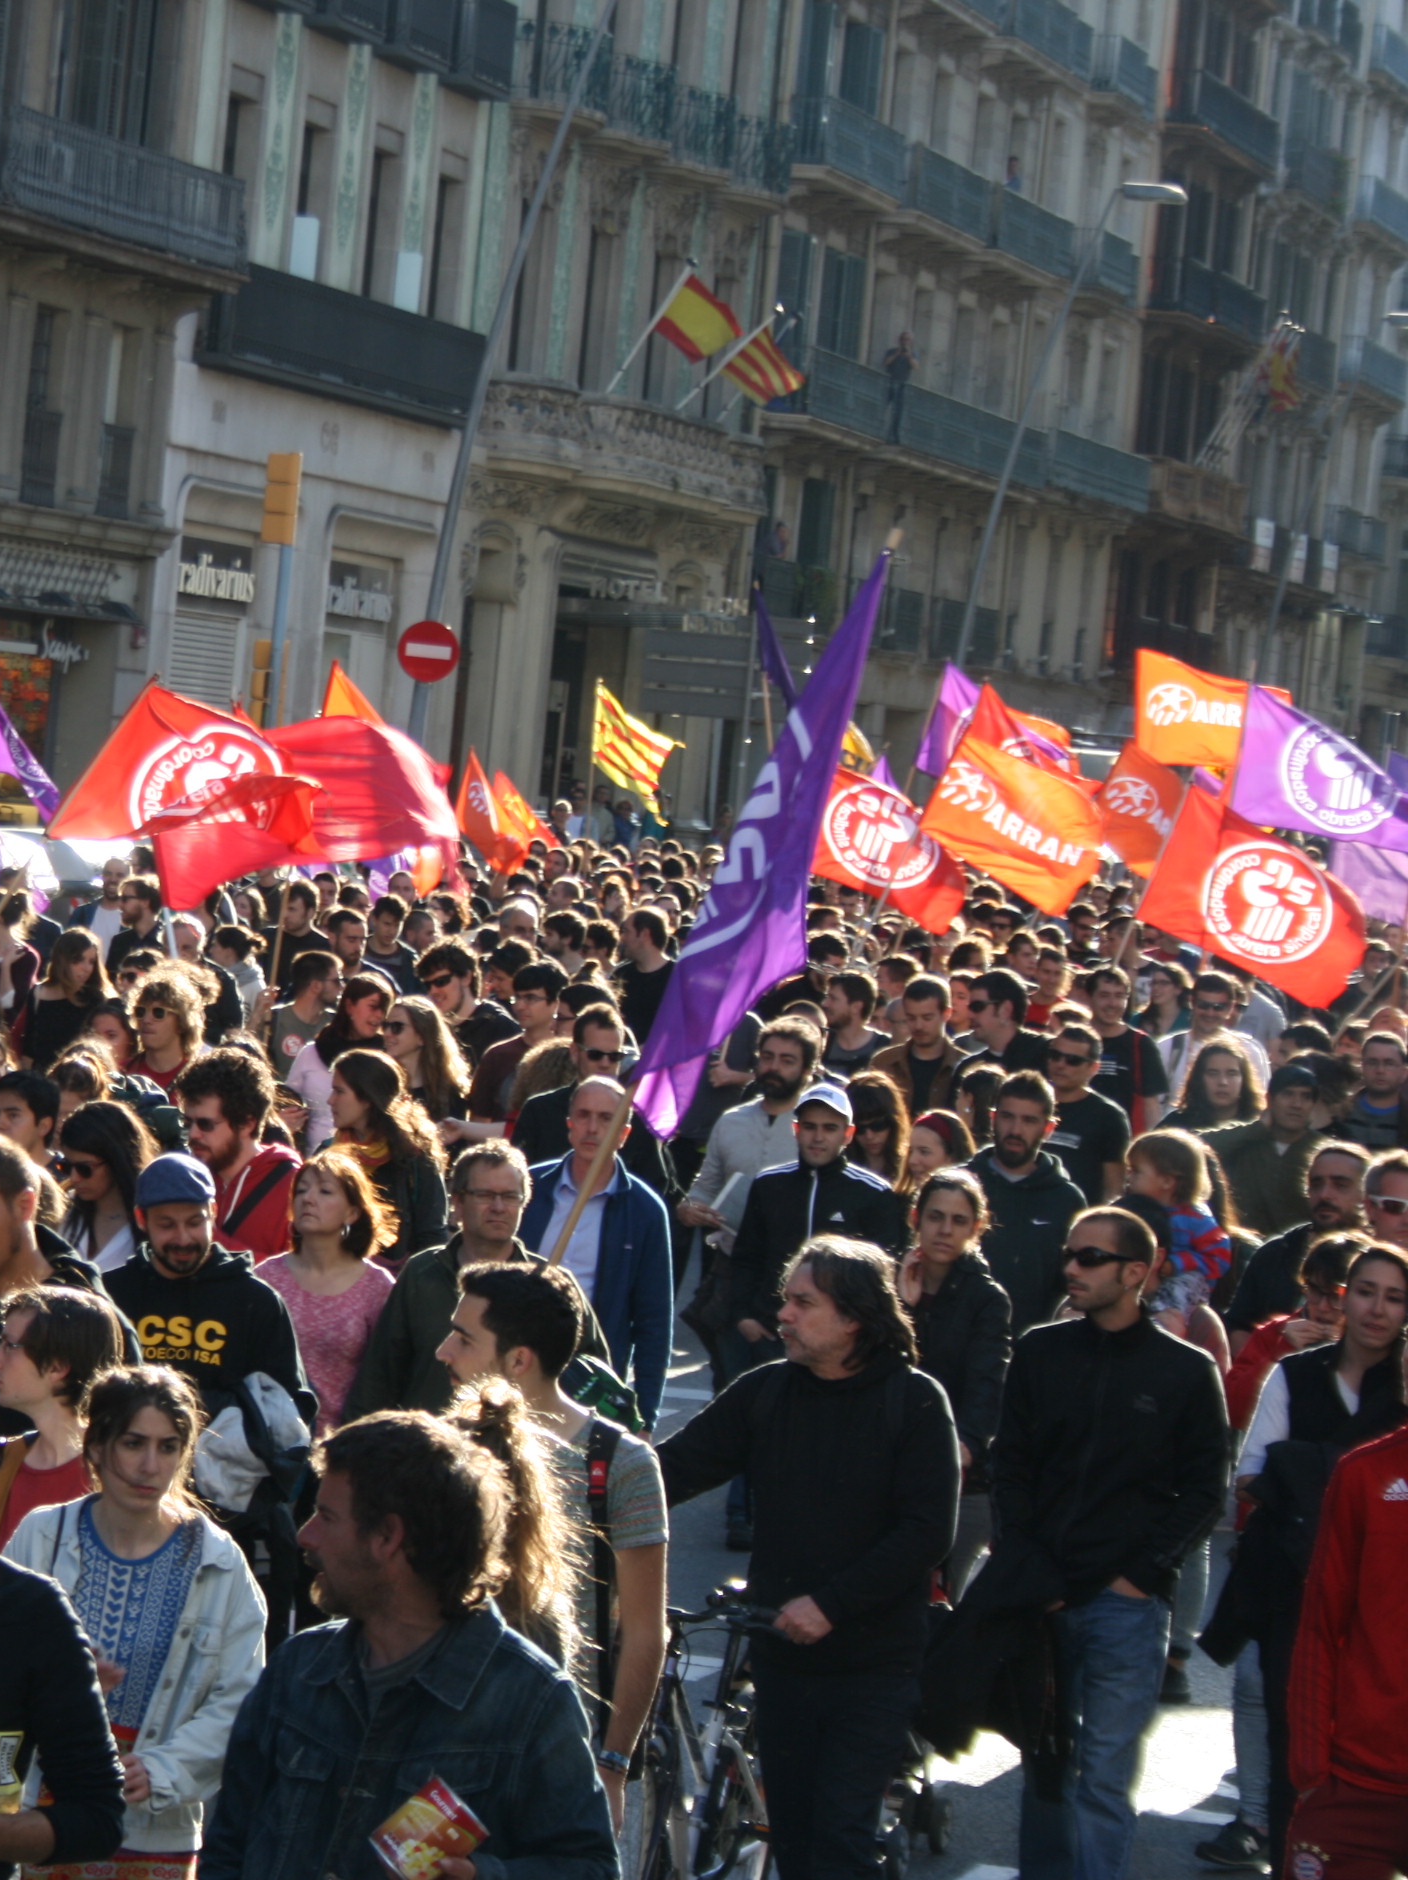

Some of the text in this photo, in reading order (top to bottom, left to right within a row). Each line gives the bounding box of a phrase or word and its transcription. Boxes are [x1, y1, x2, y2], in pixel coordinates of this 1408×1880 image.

[982, 803, 1085, 867] ARRAN
[1318, 809, 1373, 827] obrera
[1210, 854, 1261, 932] coordinadora
[1230, 933, 1281, 957] obrera
[1283, 907, 1322, 954] sindical
[137, 1314, 227, 1351] CSC
